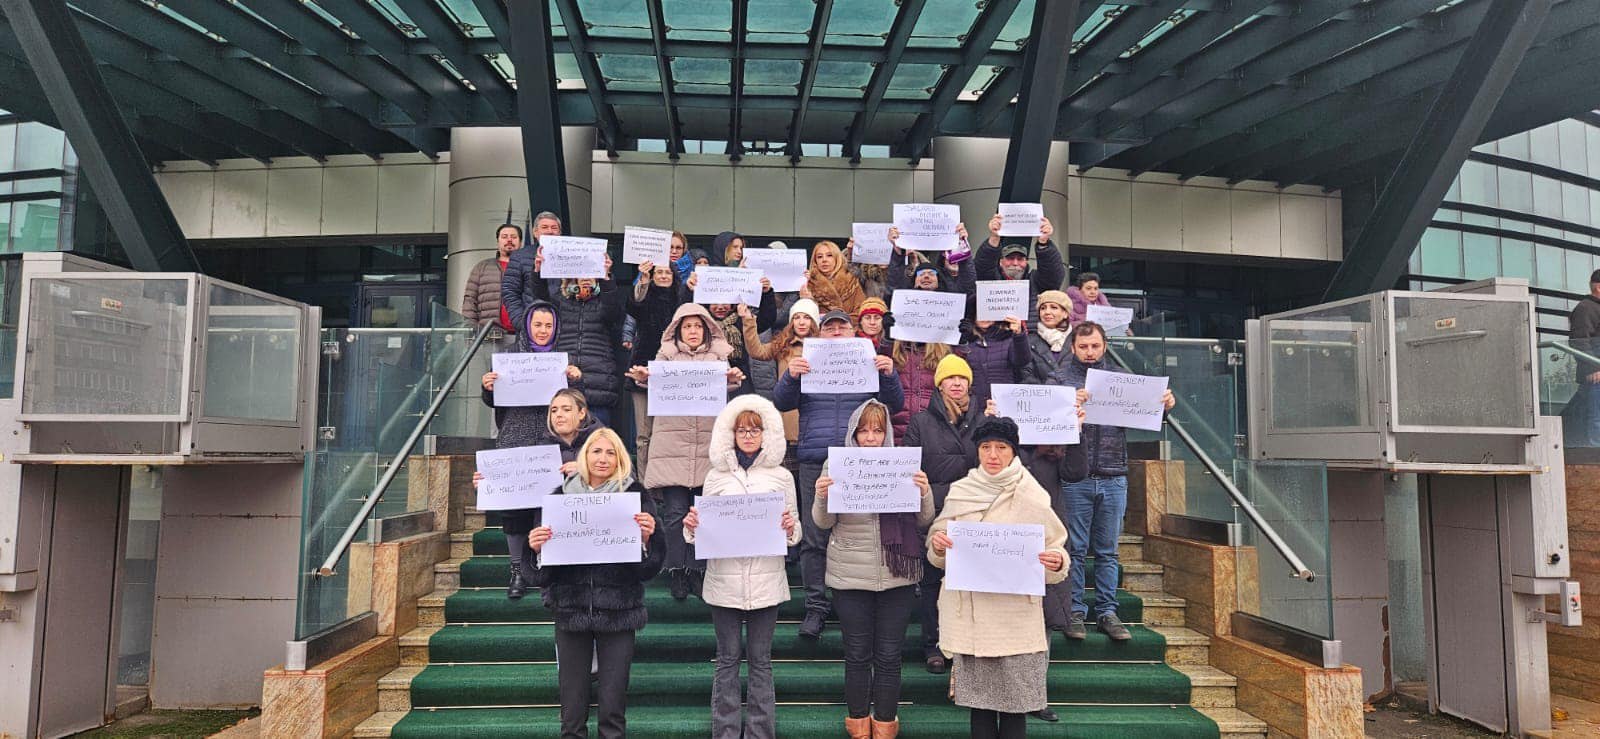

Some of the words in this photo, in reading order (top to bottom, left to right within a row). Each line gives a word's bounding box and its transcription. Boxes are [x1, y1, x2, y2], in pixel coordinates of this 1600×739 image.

[1109, 386, 1123, 399] NU
[1016, 399, 1031, 413] NU
[563, 495, 612, 506] SPUNEM
[571, 509, 588, 525] NU
